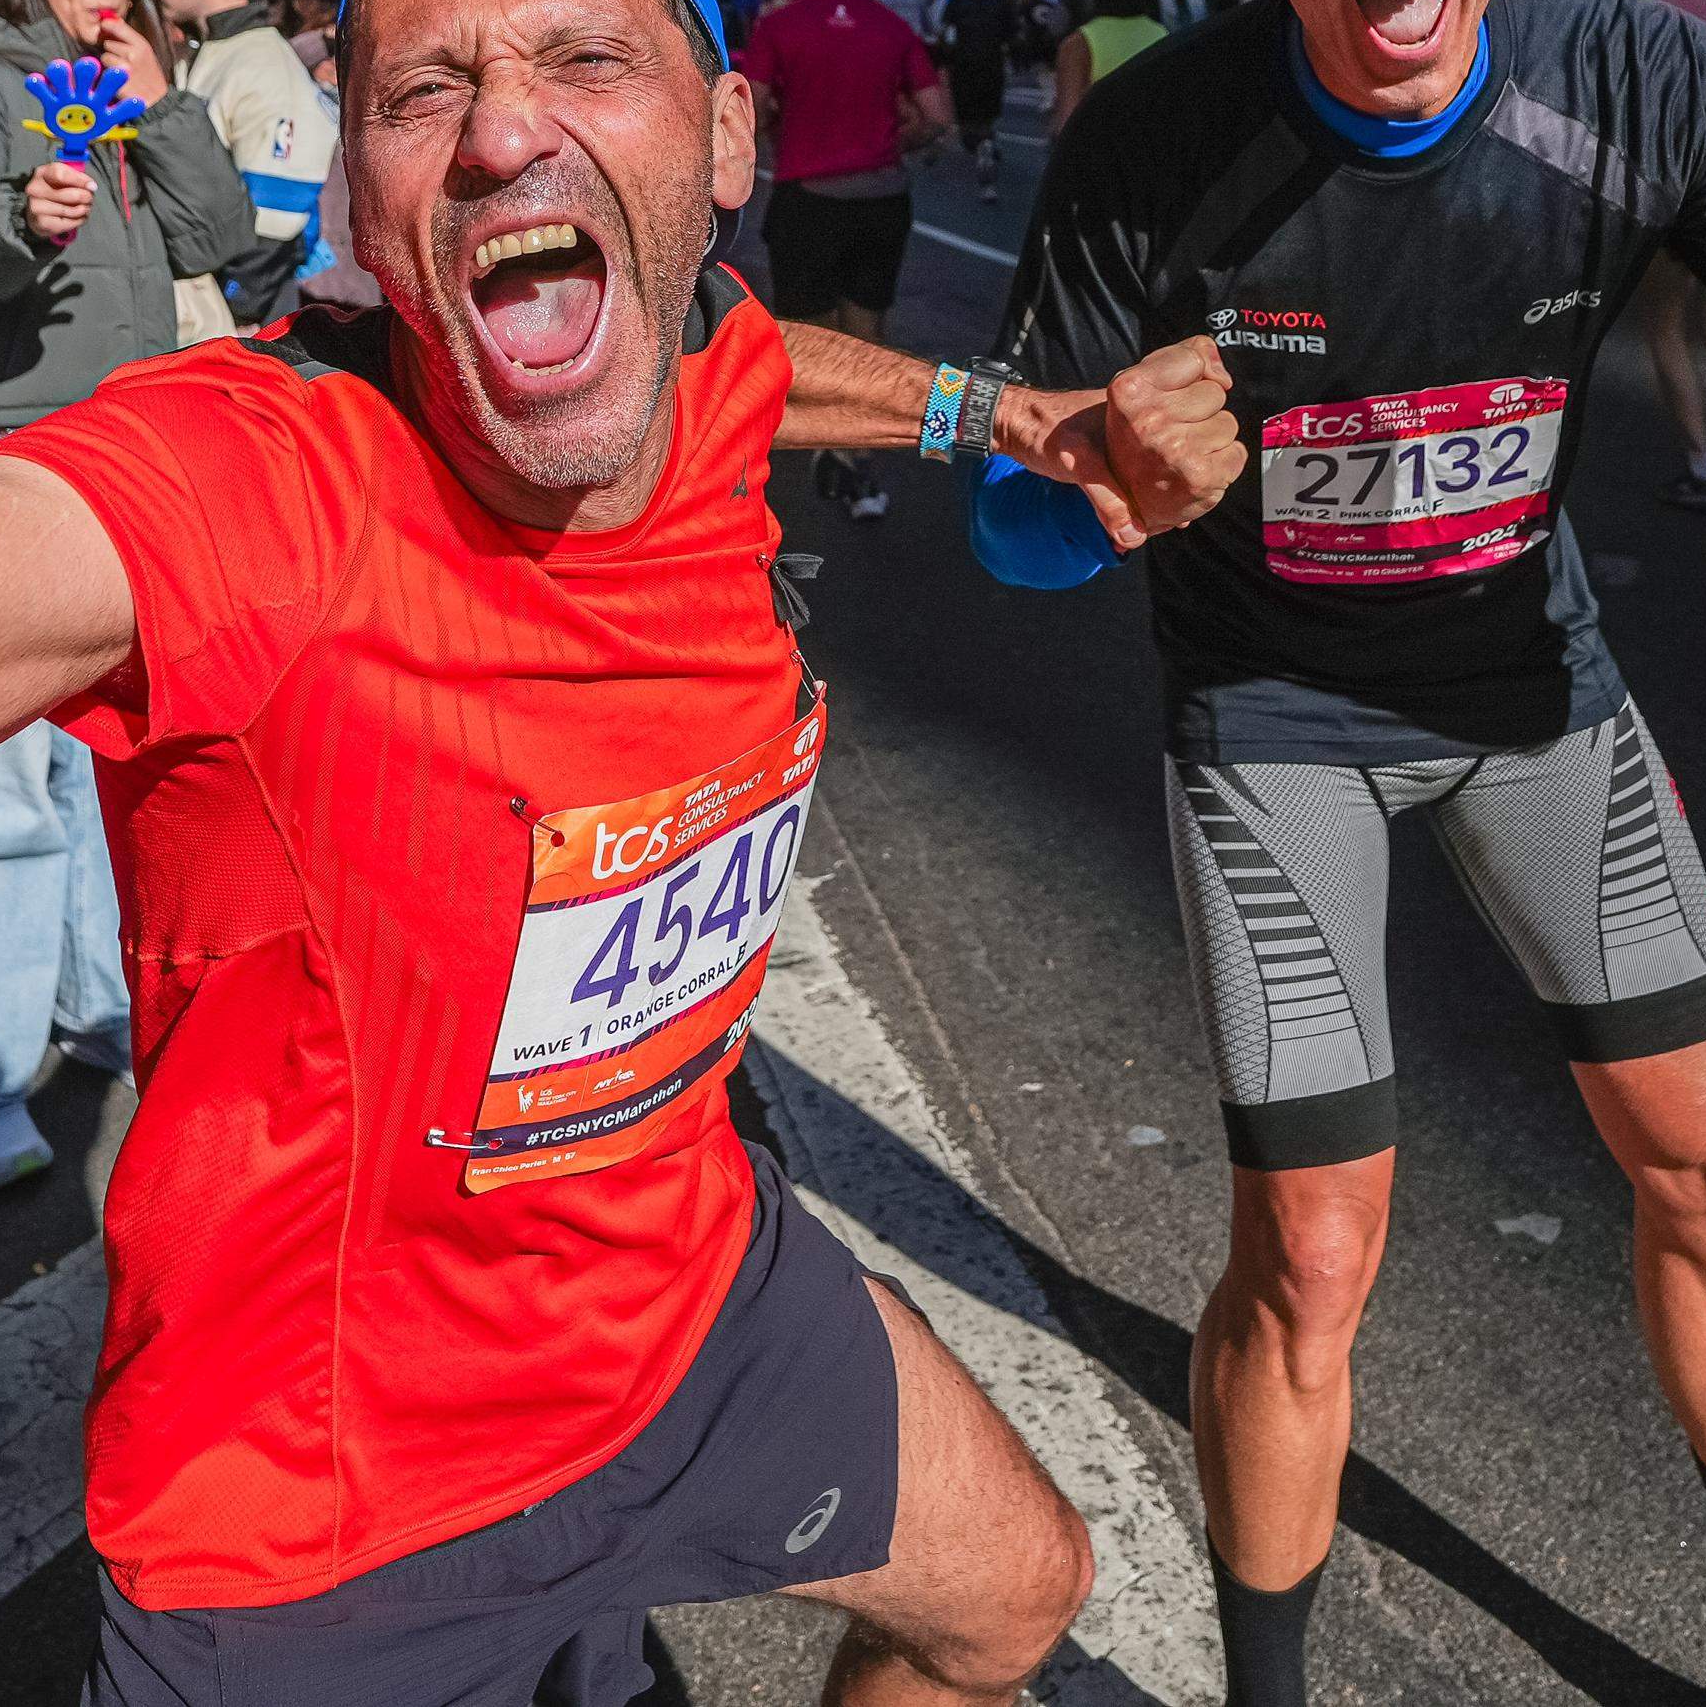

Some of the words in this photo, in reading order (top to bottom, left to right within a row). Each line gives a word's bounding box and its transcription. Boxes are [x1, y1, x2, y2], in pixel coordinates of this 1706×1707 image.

[1550, 289, 1602, 314] asics
[1240, 308, 1327, 329] TOYOTA
[1370, 399, 1409, 413] TATA
[1370, 402, 1459, 422] CONSULTANCY
[1483, 401, 1528, 420] TATA
[1301, 412, 1364, 439] tcs
[1370, 417, 1427, 434] SERVICES
[1294, 425, 1531, 506] 27132
[1274, 507, 1314, 518] WAVE
[1316, 508, 1331, 520] 2
[1339, 510, 1372, 519] PINK
[1374, 503, 1430, 518] CORRAL
[1431, 497, 1445, 513] F
[1461, 522, 1519, 554] 2024
[781, 749, 816, 786] TATA
[677, 770, 765, 828] CONSULTANCY
[684, 779, 721, 809] TATA
[673, 804, 729, 849] SERVICES
[591, 816, 674, 880] tcs
[570, 804, 800, 1009] 4540
[513, 1035, 571, 1061] WAVE
[578, 1024, 593, 1047] 1
[606, 991, 675, 1035] ORANGE
[677, 958, 733, 1000] CORRAL
[525, 1077, 683, 1146] #TCSNYCMarathon
[471, 1167, 492, 1177] Fran
